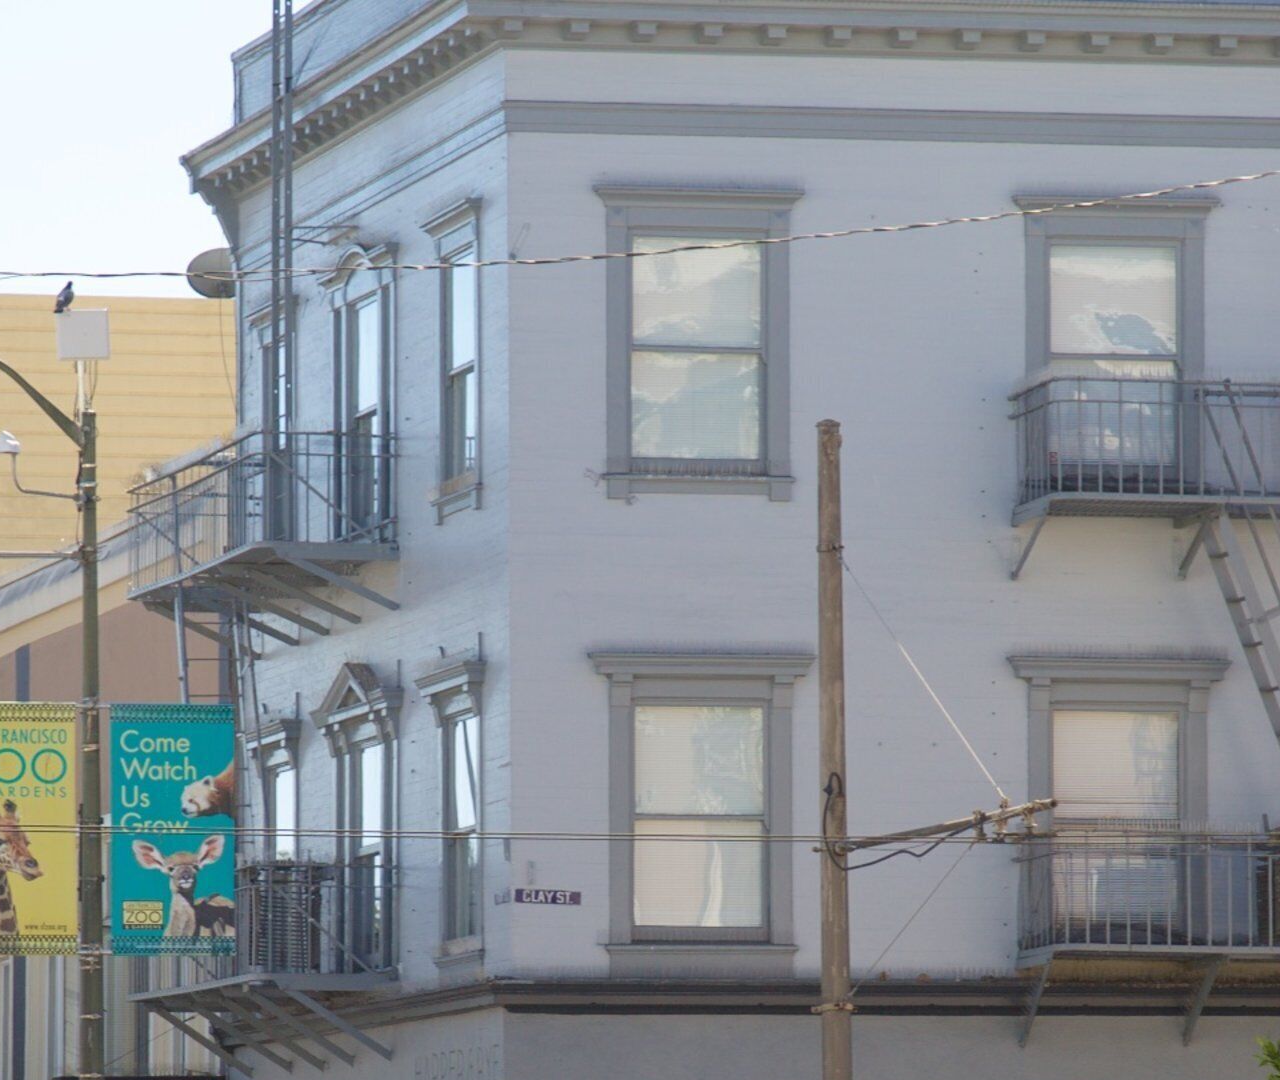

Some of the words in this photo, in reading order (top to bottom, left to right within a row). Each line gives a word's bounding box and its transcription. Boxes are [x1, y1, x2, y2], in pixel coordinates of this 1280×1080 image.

[120, 729, 191, 753] Come
[120, 757, 197, 781] Watch
[121, 786, 150, 808] Us
[120, 812, 190, 835] Grow
[522, 890, 554, 903] CLAY
[125, 911, 162, 924] ZOO
